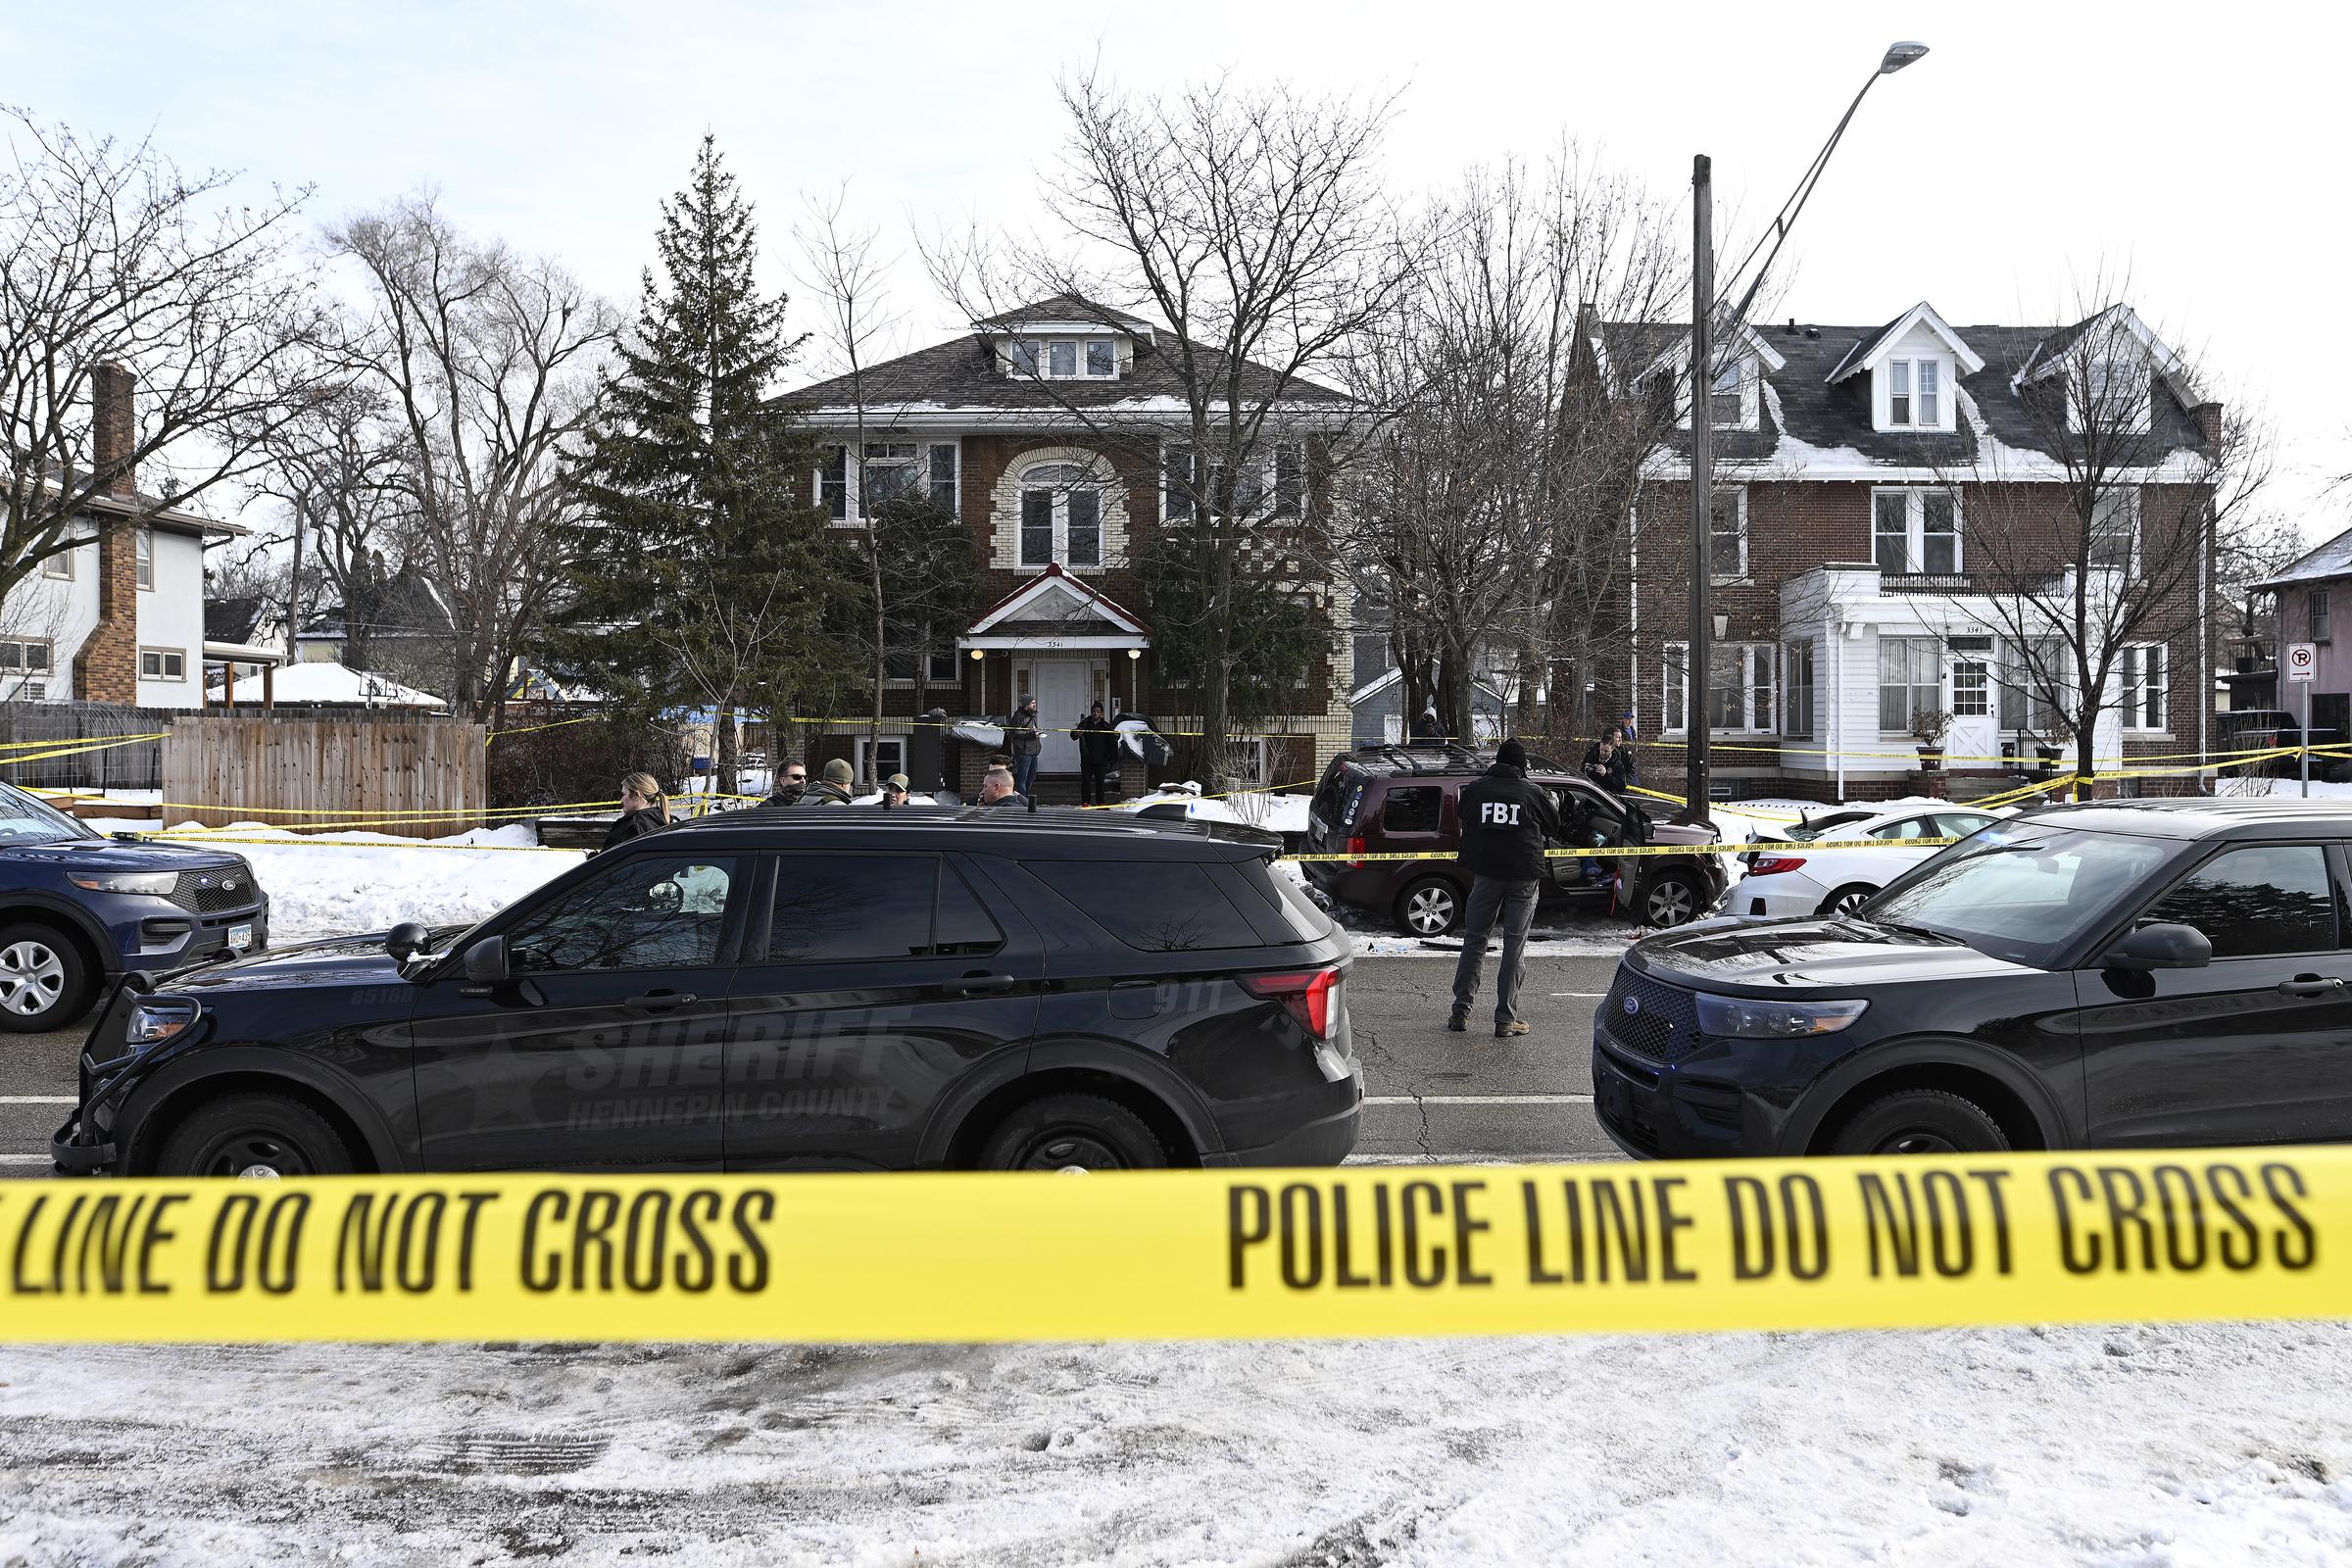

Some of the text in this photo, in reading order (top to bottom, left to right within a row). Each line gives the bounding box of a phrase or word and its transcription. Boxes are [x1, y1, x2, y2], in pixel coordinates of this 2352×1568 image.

[1481, 802, 1521, 825] FBI
[1152, 977, 1224, 1012] 911
[563, 1006, 913, 1092] SHERIFF
[566, 1086, 893, 1132] HENNEPIN COUNTY
[8, 1188, 777, 1297] LINE DO NOT CROSS
[1228, 1160, 2318, 1291] POLICE LINE DO NOT CROSS
